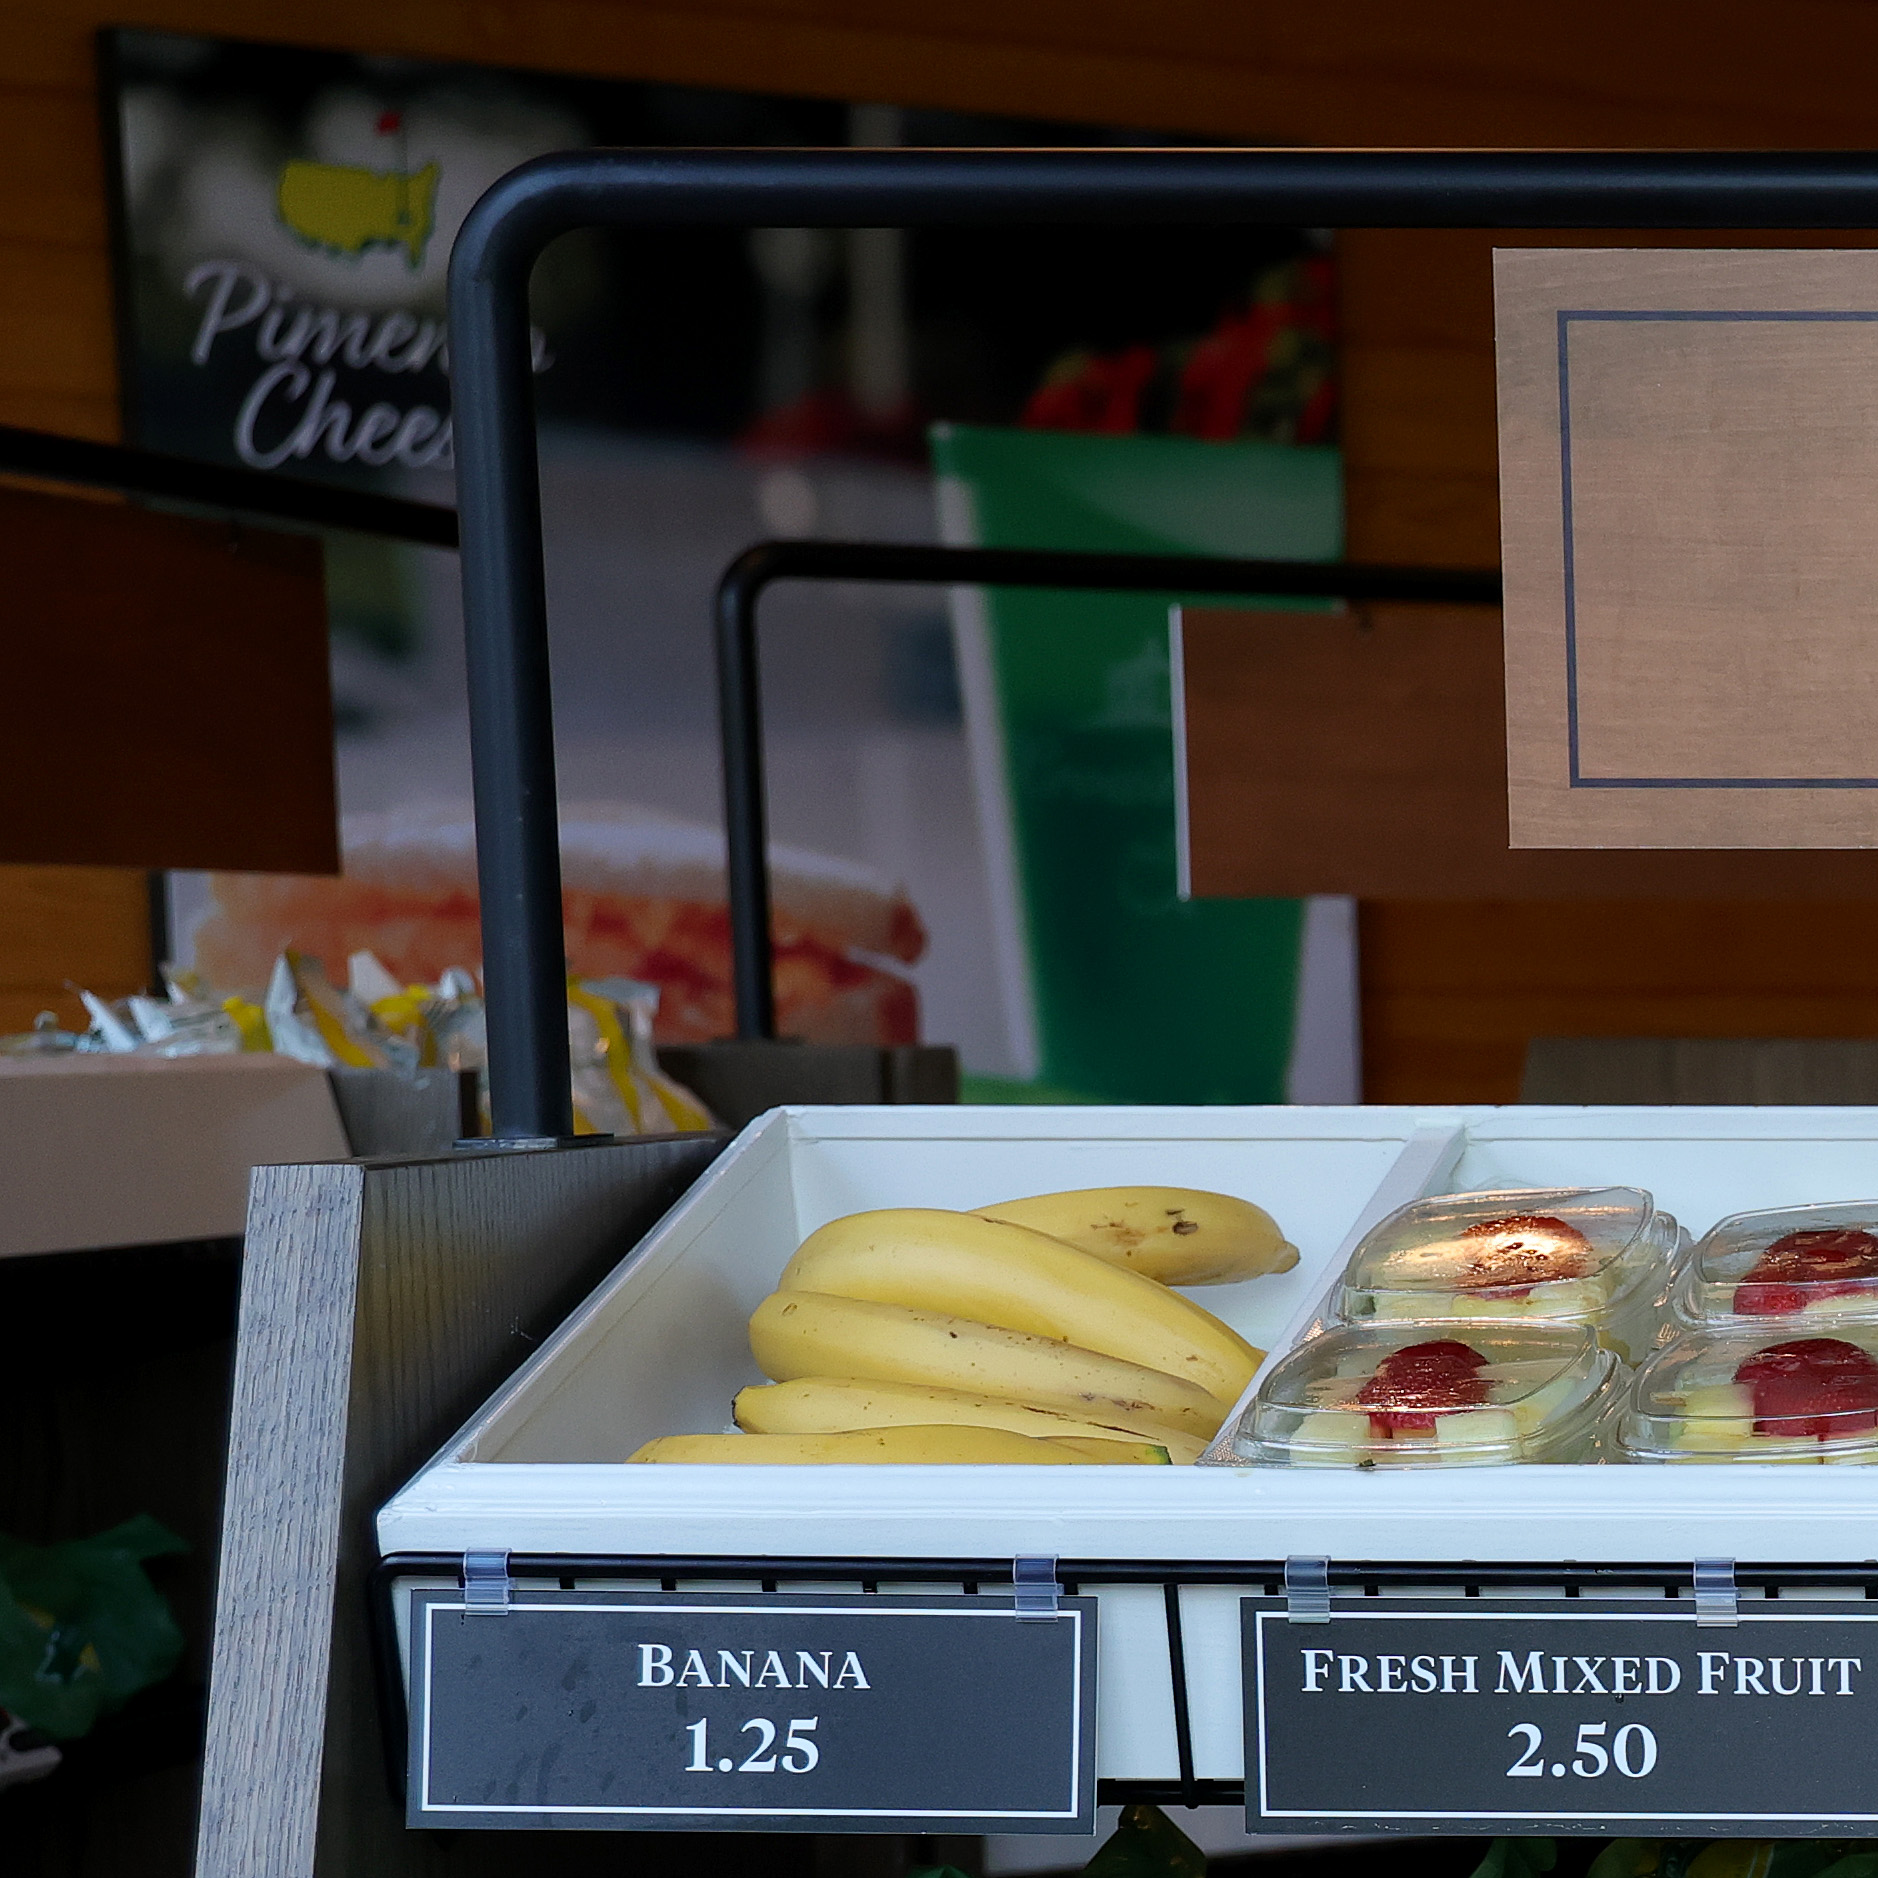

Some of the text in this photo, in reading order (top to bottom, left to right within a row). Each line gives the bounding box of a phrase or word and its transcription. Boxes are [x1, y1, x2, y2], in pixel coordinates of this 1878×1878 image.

[637, 1644, 870, 1688] BANANA
[1301, 1650, 1861, 1698] FRESH MIXED FRUIT
[685, 1717, 818, 1773] 1.25
[1507, 1722, 1656, 1777] 2.50
